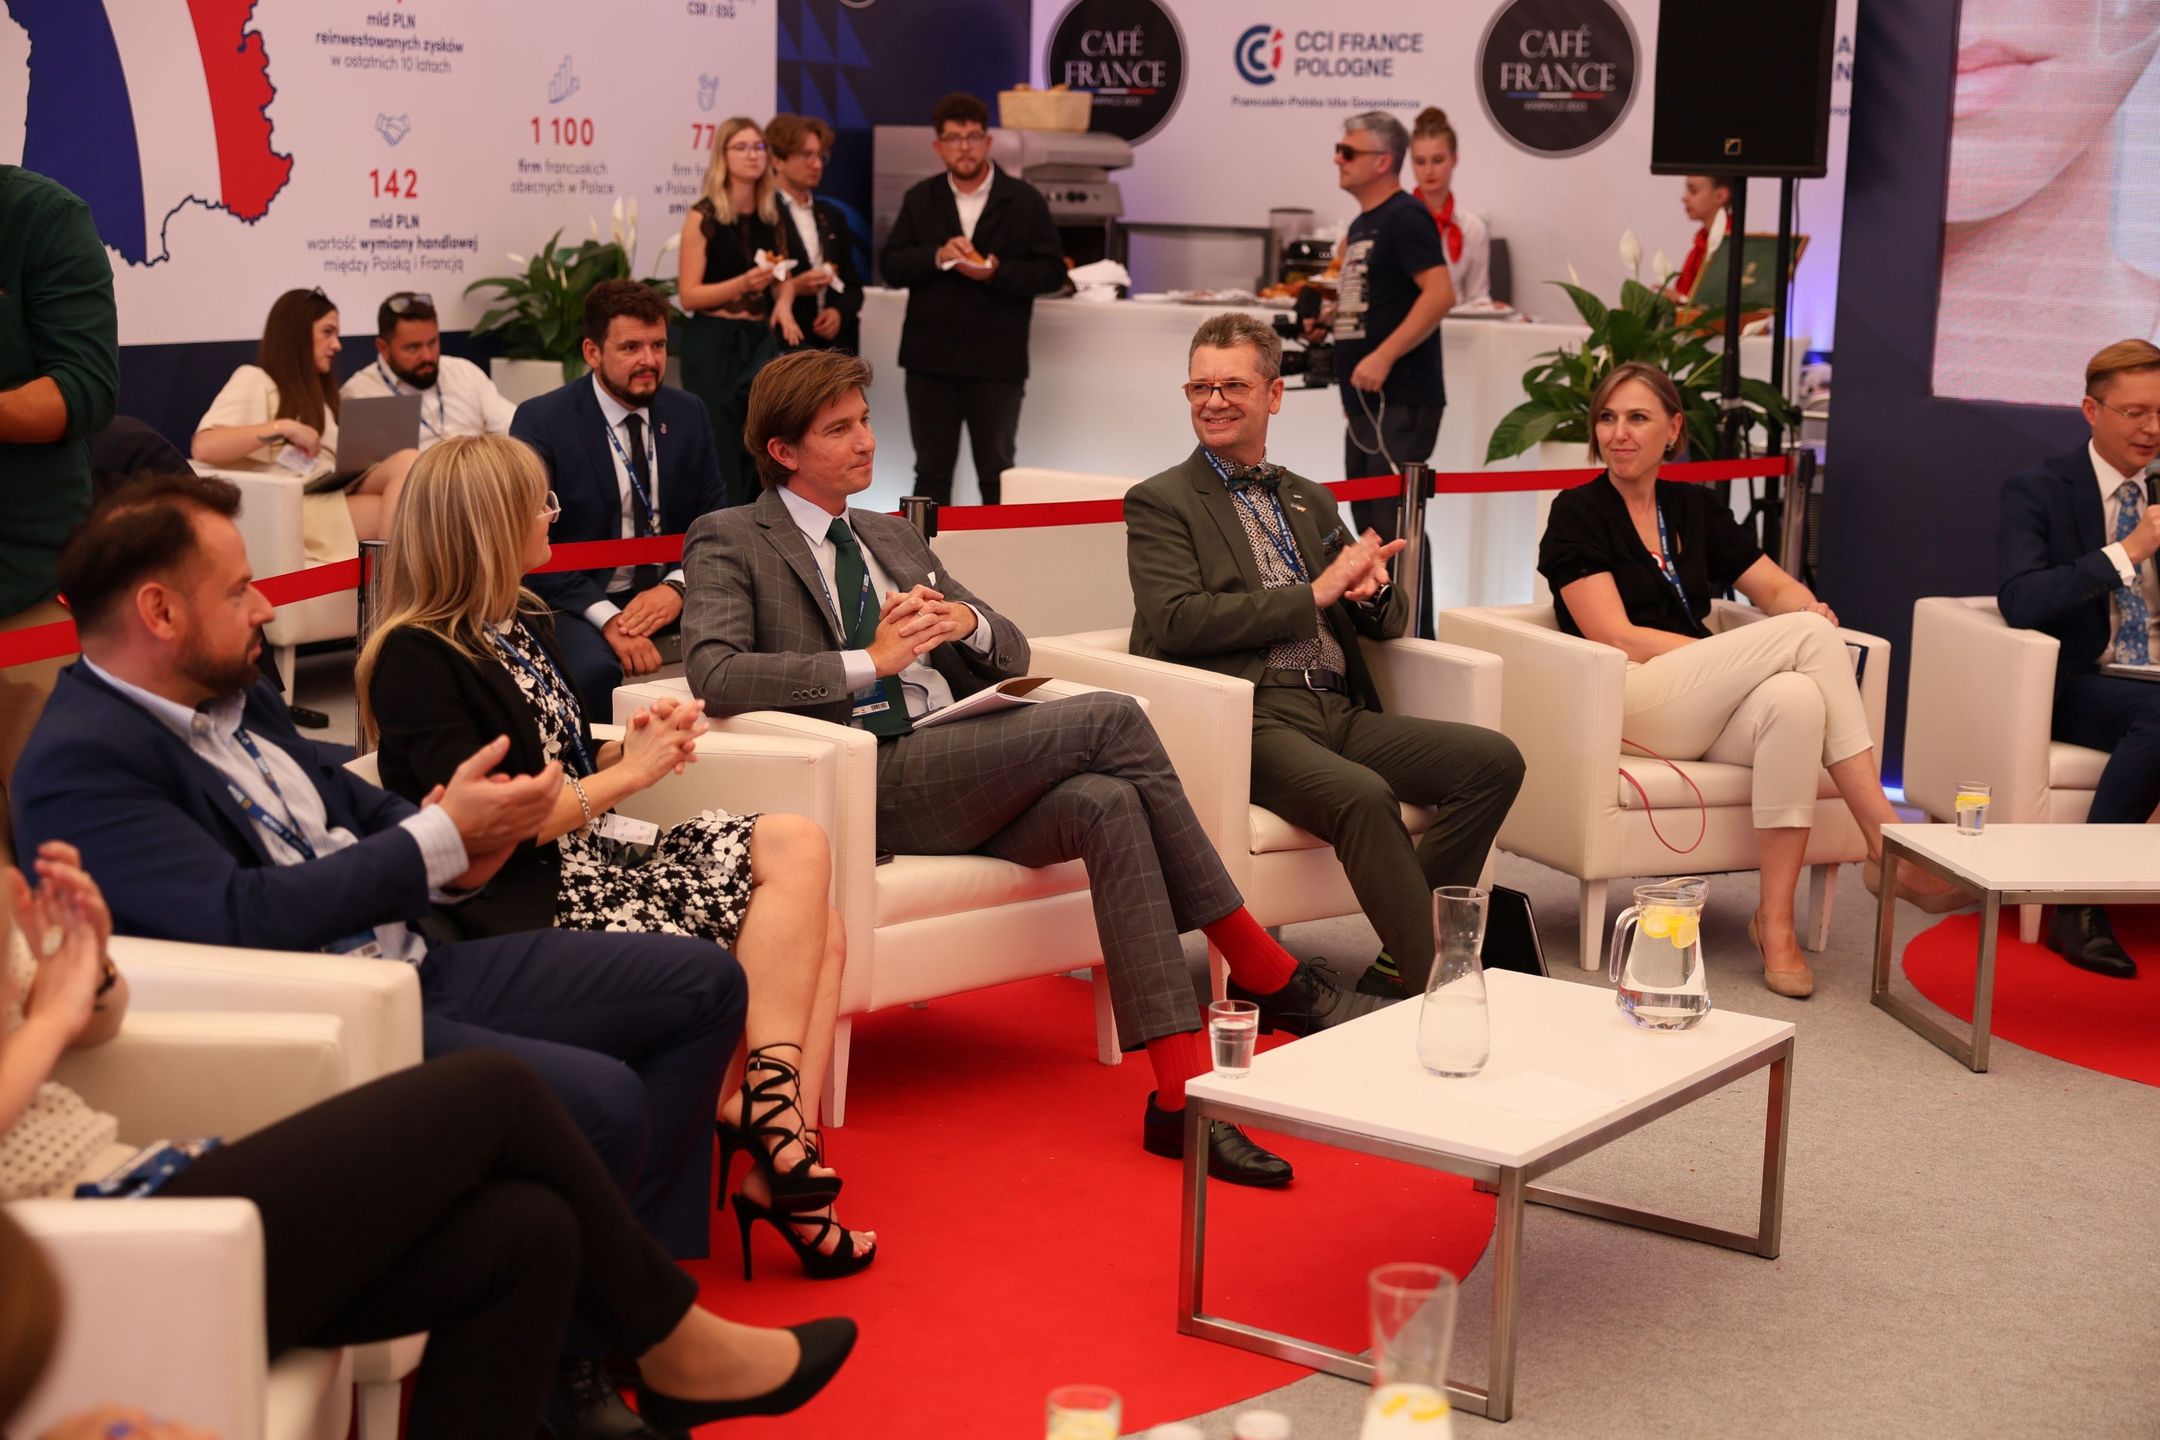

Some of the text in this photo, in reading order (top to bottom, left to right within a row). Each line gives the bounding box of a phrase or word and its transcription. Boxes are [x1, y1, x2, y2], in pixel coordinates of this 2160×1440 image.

[367, 12, 416, 29] mld PLN
[686, 1, 708, 16] CSR
[716, 4, 737, 19] ESG
[316, 28, 464, 54] reinwestowanych zysków
[1080, 24, 1145, 56] CAFÉ
[1295, 31, 1424, 53] CCI FRANCE
[1519, 23, 1592, 58] CAFÉ
[331, 54, 452, 73] w ostatnich 10 latach
[1065, 60, 1166, 87] FRANCE
[1294, 57, 1394, 78] POLOGNE
[1500, 61, 1617, 91] FRANCE
[530, 116, 594, 146] 1 100
[691, 123, 716, 151] 77
[518, 158, 608, 176] firm francuskich
[369, 168, 417, 199] 142
[511, 178, 615, 197] obecnych w Polsce
[369, 214, 420, 229] mld PLN
[307, 233, 478, 254] wartość wymiany handlowej
[324, 255, 368, 274] między
[372, 255, 411, 273] Polską
[420, 255, 464, 273] Francją
